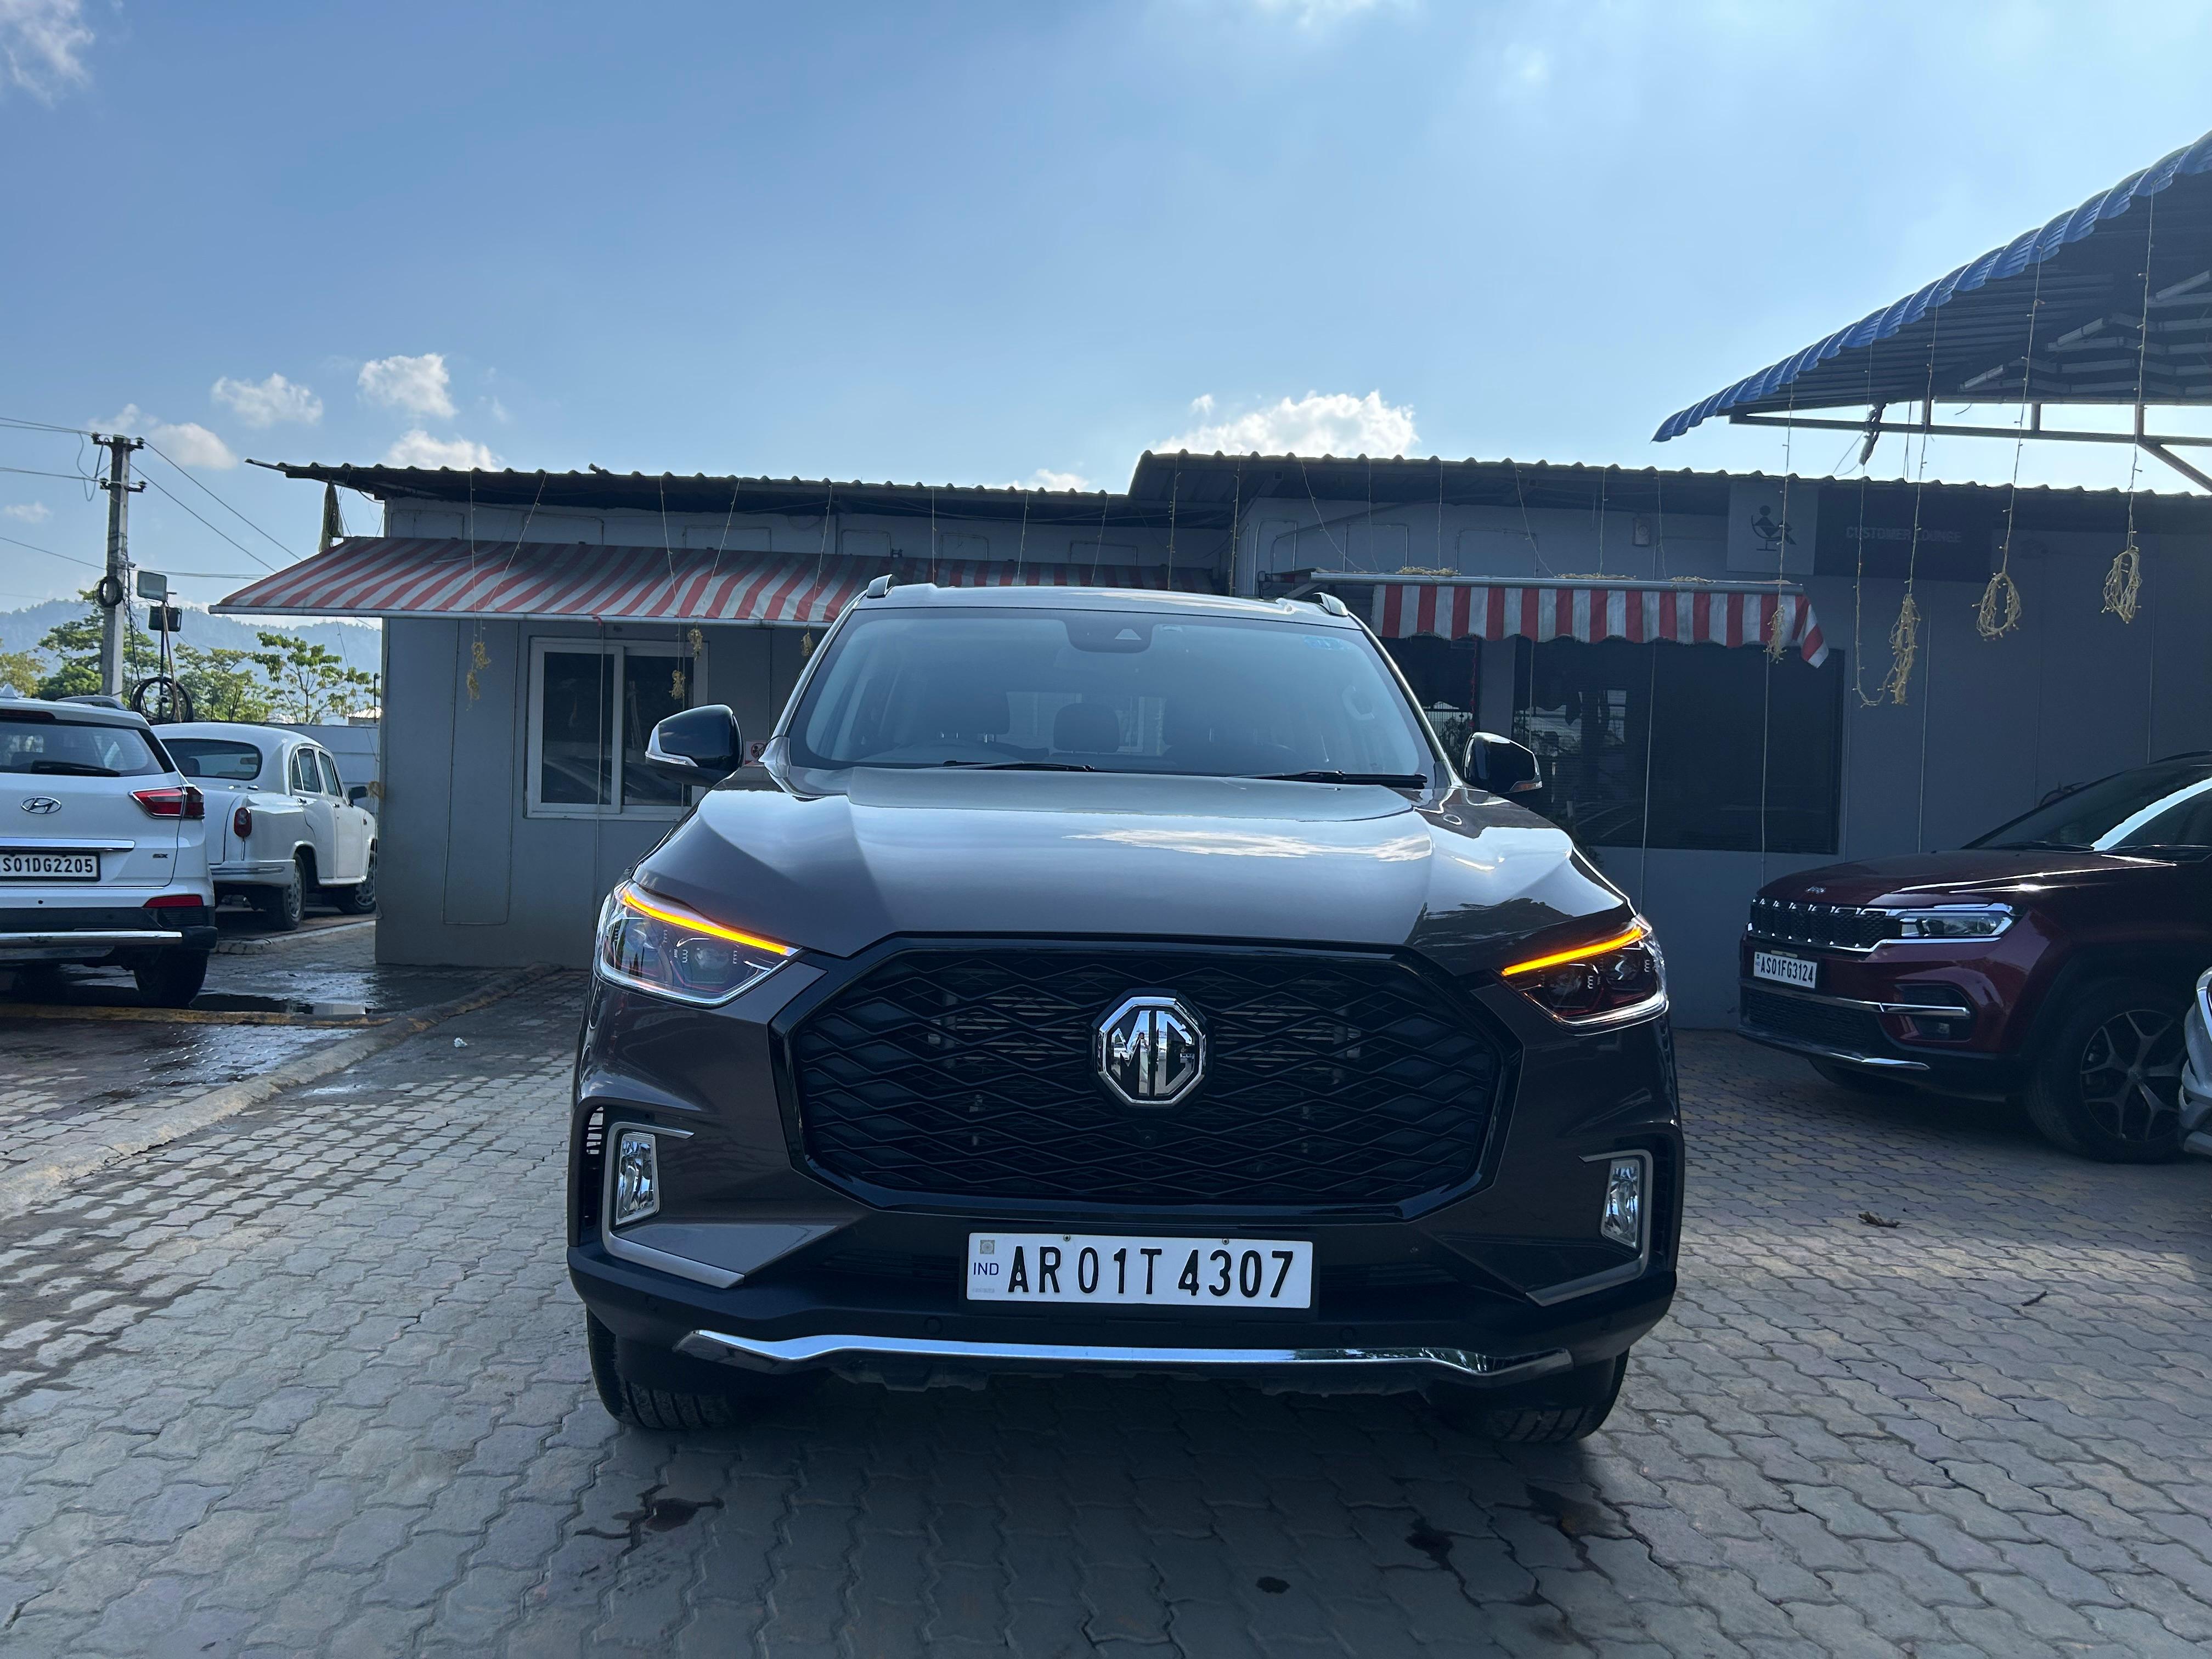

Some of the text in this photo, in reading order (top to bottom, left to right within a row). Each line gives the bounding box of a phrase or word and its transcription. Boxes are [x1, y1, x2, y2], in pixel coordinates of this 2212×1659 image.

[1916, 529, 1962, 543] OUNGE
[0, 857, 93, 873] S01DG2205
[1760, 956, 1813, 983] AS01FG3124
[1111, 1010, 1195, 1097] MG
[973, 1262, 999, 1276] IND
